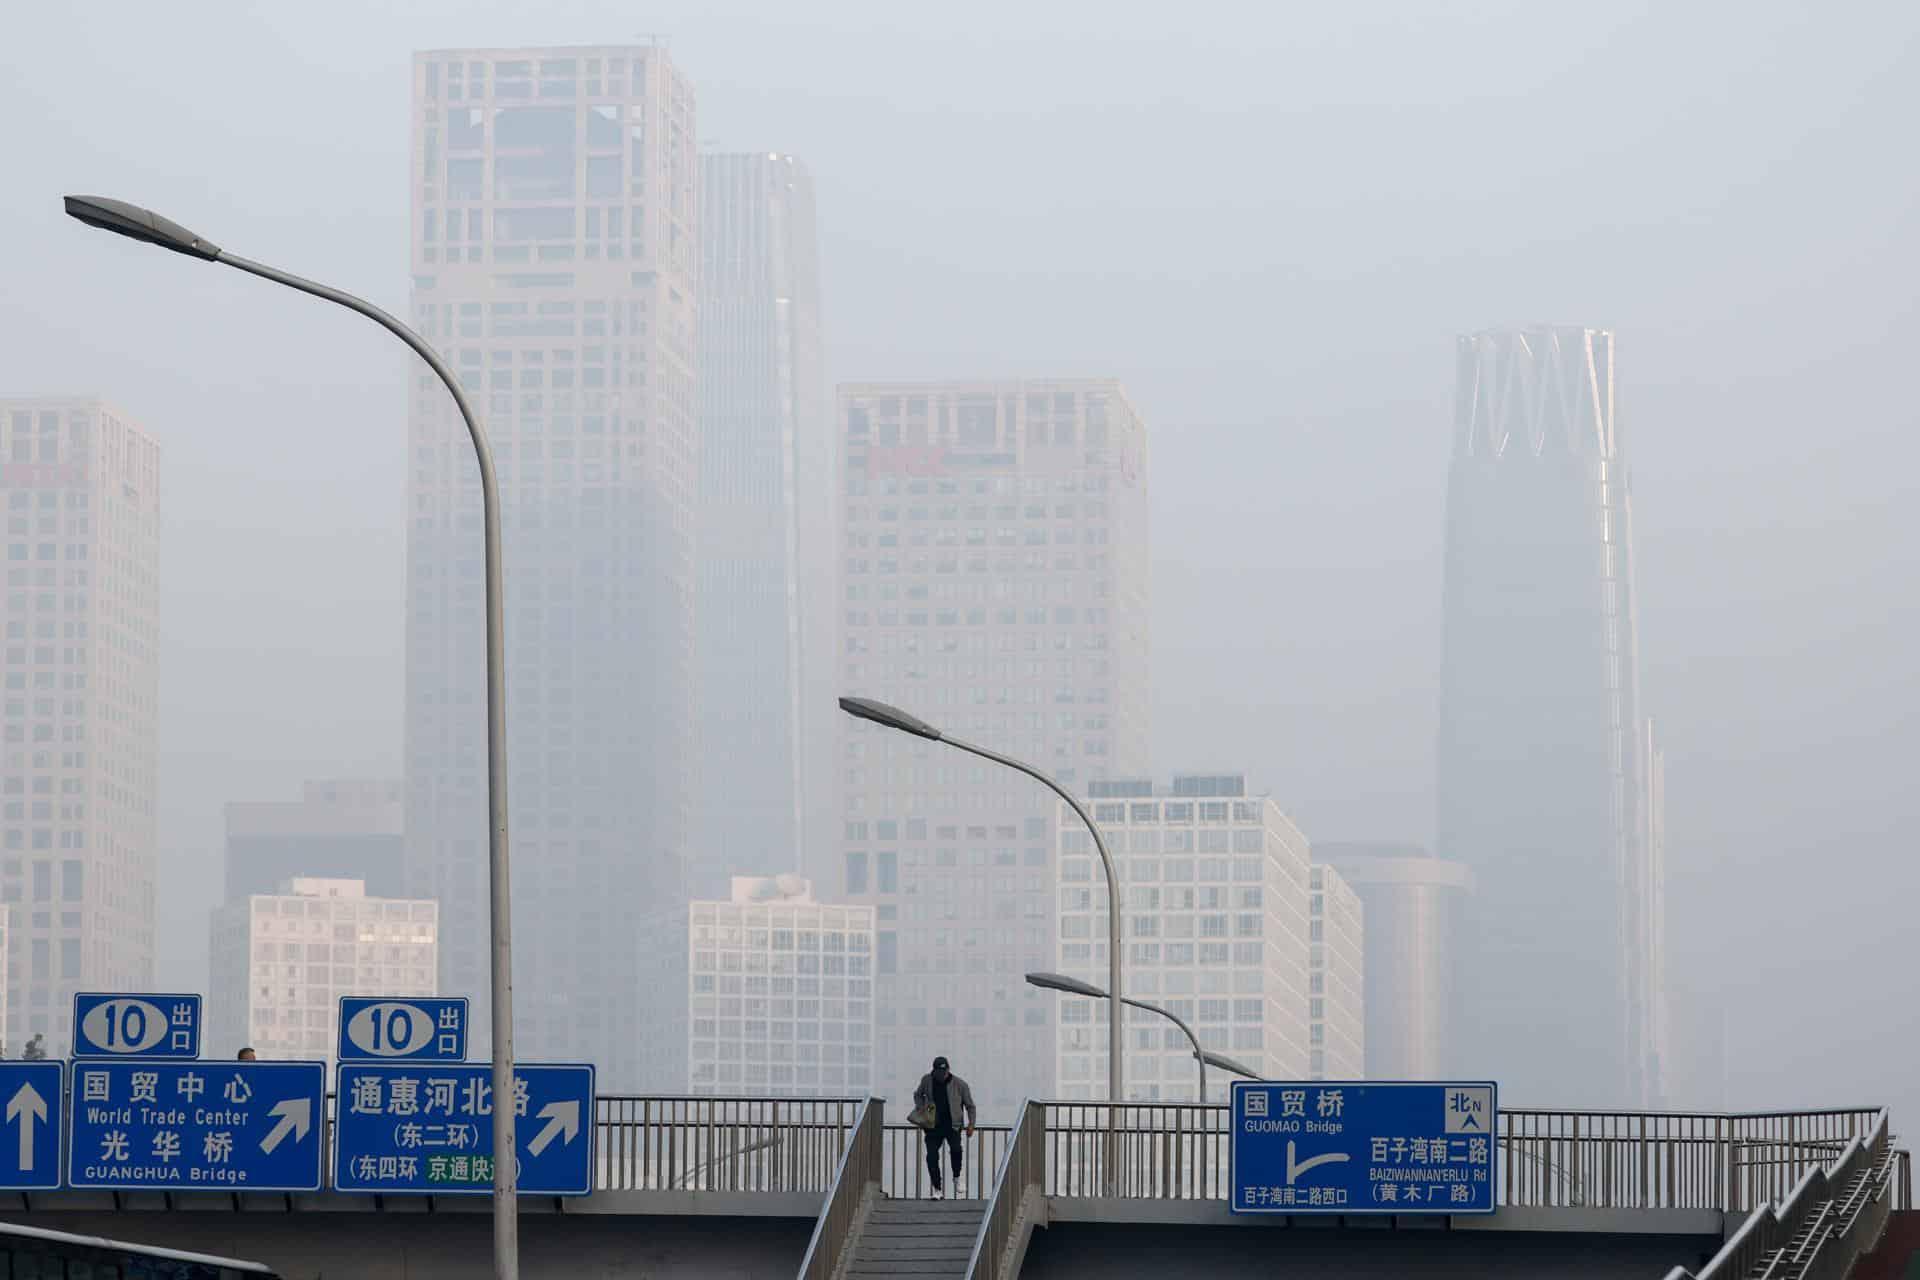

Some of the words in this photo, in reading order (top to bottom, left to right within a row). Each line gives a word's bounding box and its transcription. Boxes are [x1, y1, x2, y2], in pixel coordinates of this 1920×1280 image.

[105, 1004, 146, 1047] 10
[172, 1003, 192, 1050] 出口
[371, 1008, 413, 1051] 10
[438, 1006, 459, 1054] 出口
[83, 1071, 252, 1103] 国贸中心
[87, 1108, 131, 1125] World
[141, 1108, 185, 1125] Trade
[195, 1108, 249, 1126] Center
[1244, 1089, 1344, 1117] 国贸桥
[394, 1122, 479, 1149] (东二环)
[1244, 1120, 1300, 1133] GUOMAO
[1306, 1120, 1343, 1135] Bridge
[101, 1130, 233, 1163] 光华桥
[1370, 1136, 1488, 1165] 百子湾南二路
[85, 1166, 180, 1180] GUANGHUA
[190, 1167, 247, 1184] Bridge
[1369, 1167, 1469, 1182] BAIZIWANNAN'ERLU
[1473, 1169, 1487, 1182] Rd
